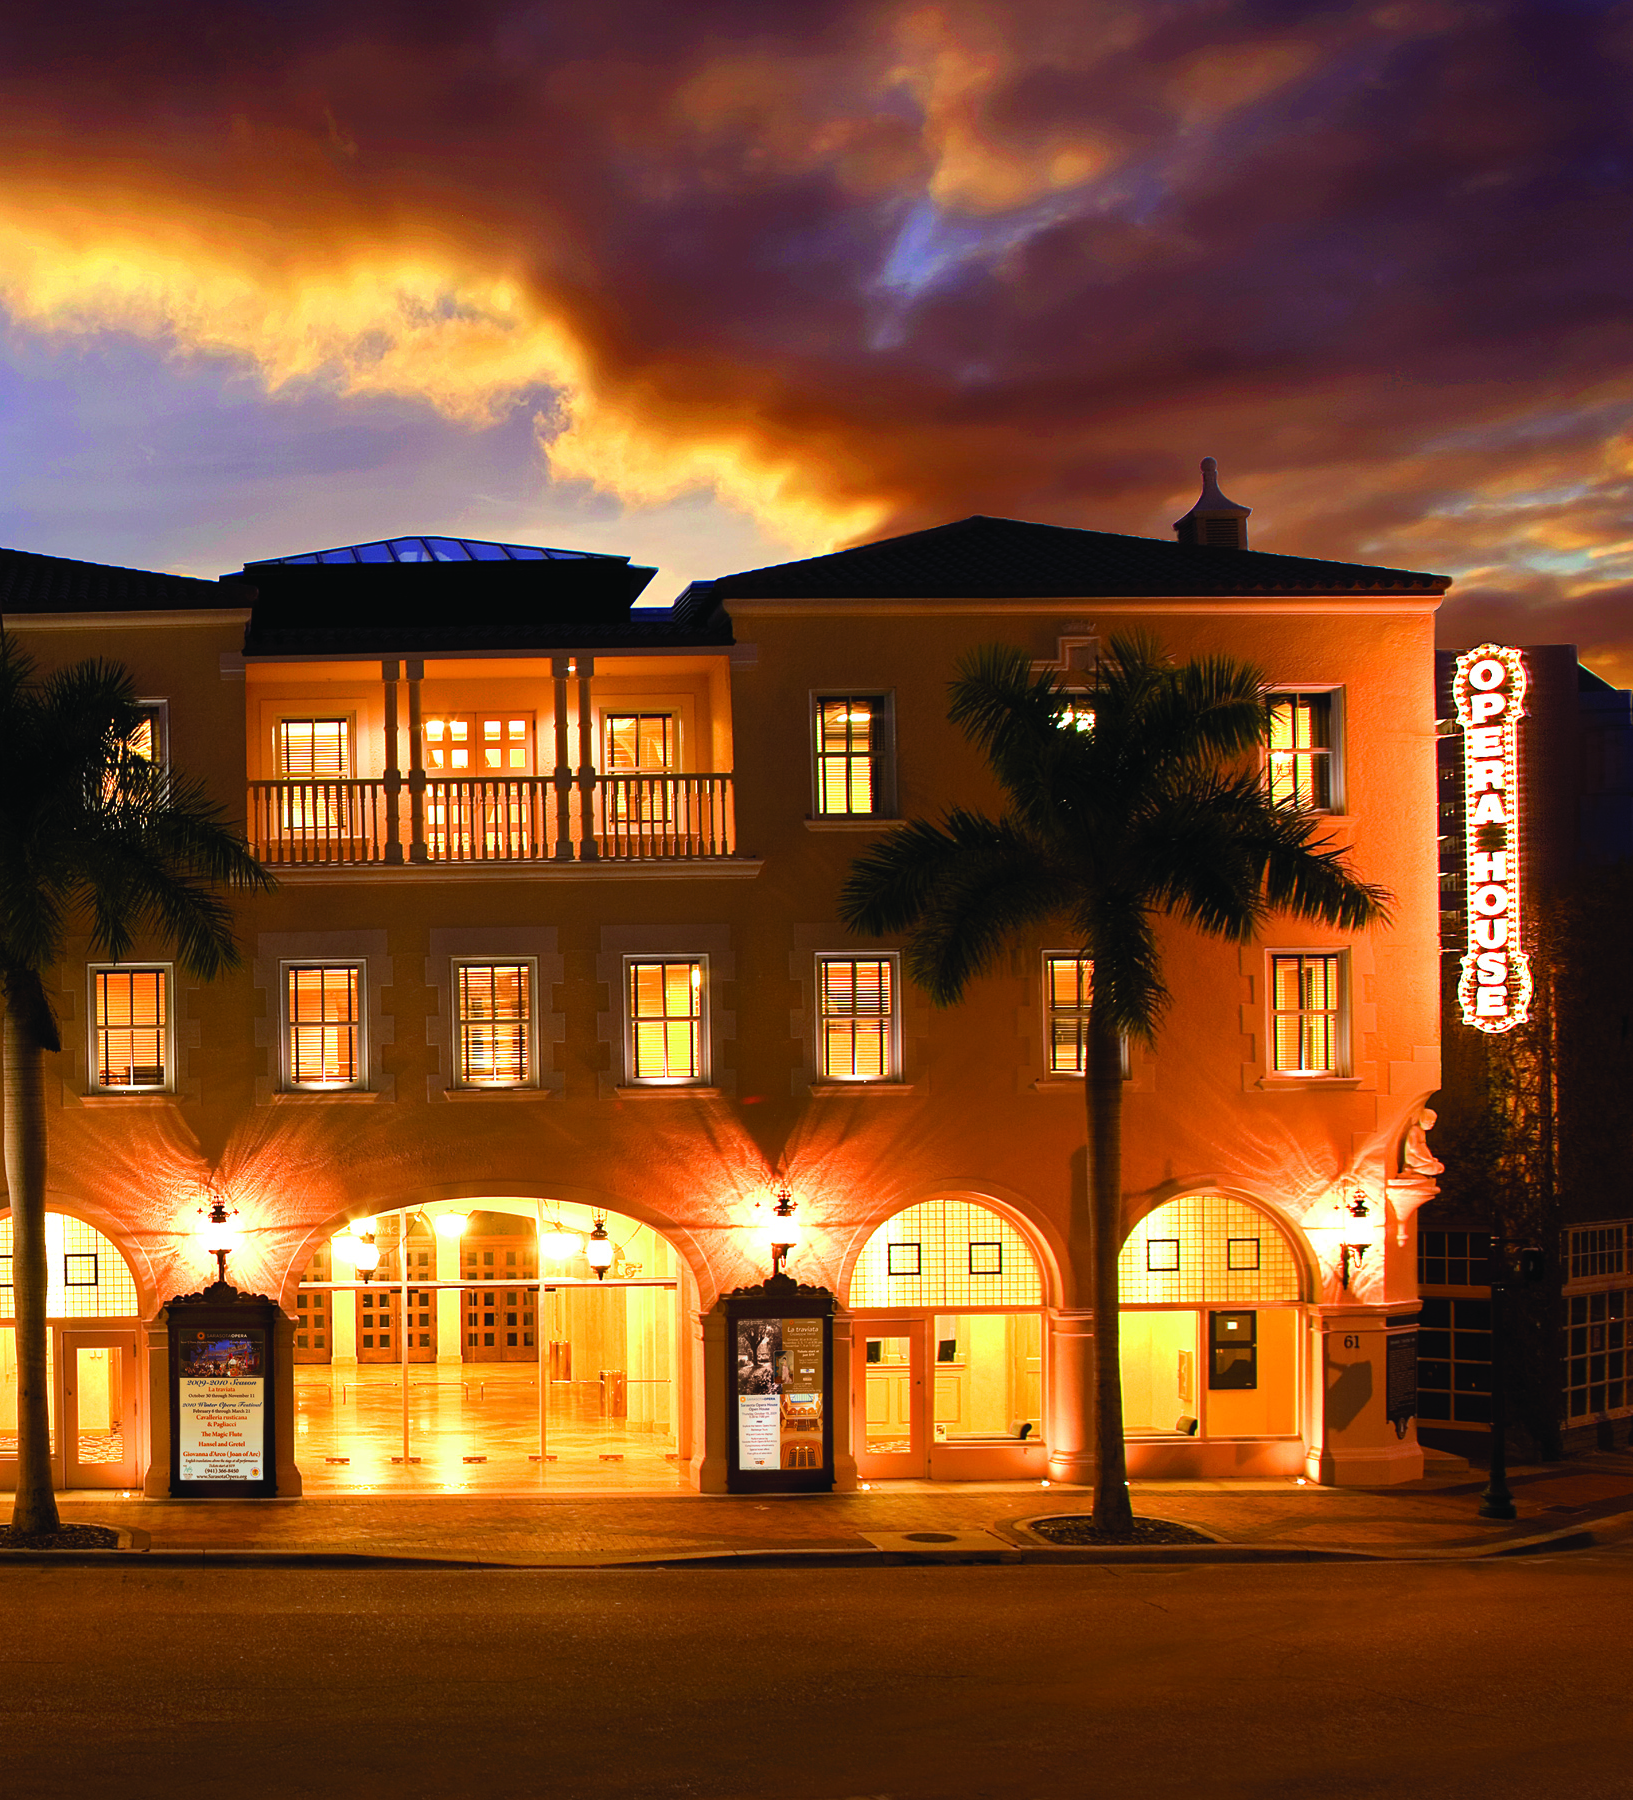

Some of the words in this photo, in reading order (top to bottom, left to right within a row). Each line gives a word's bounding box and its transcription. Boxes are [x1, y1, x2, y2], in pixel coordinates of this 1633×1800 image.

[1468, 658, 1508, 825] OPERA
[1472, 850, 1509, 1017] HOUSE
[1344, 1334, 1360, 1348] 61
